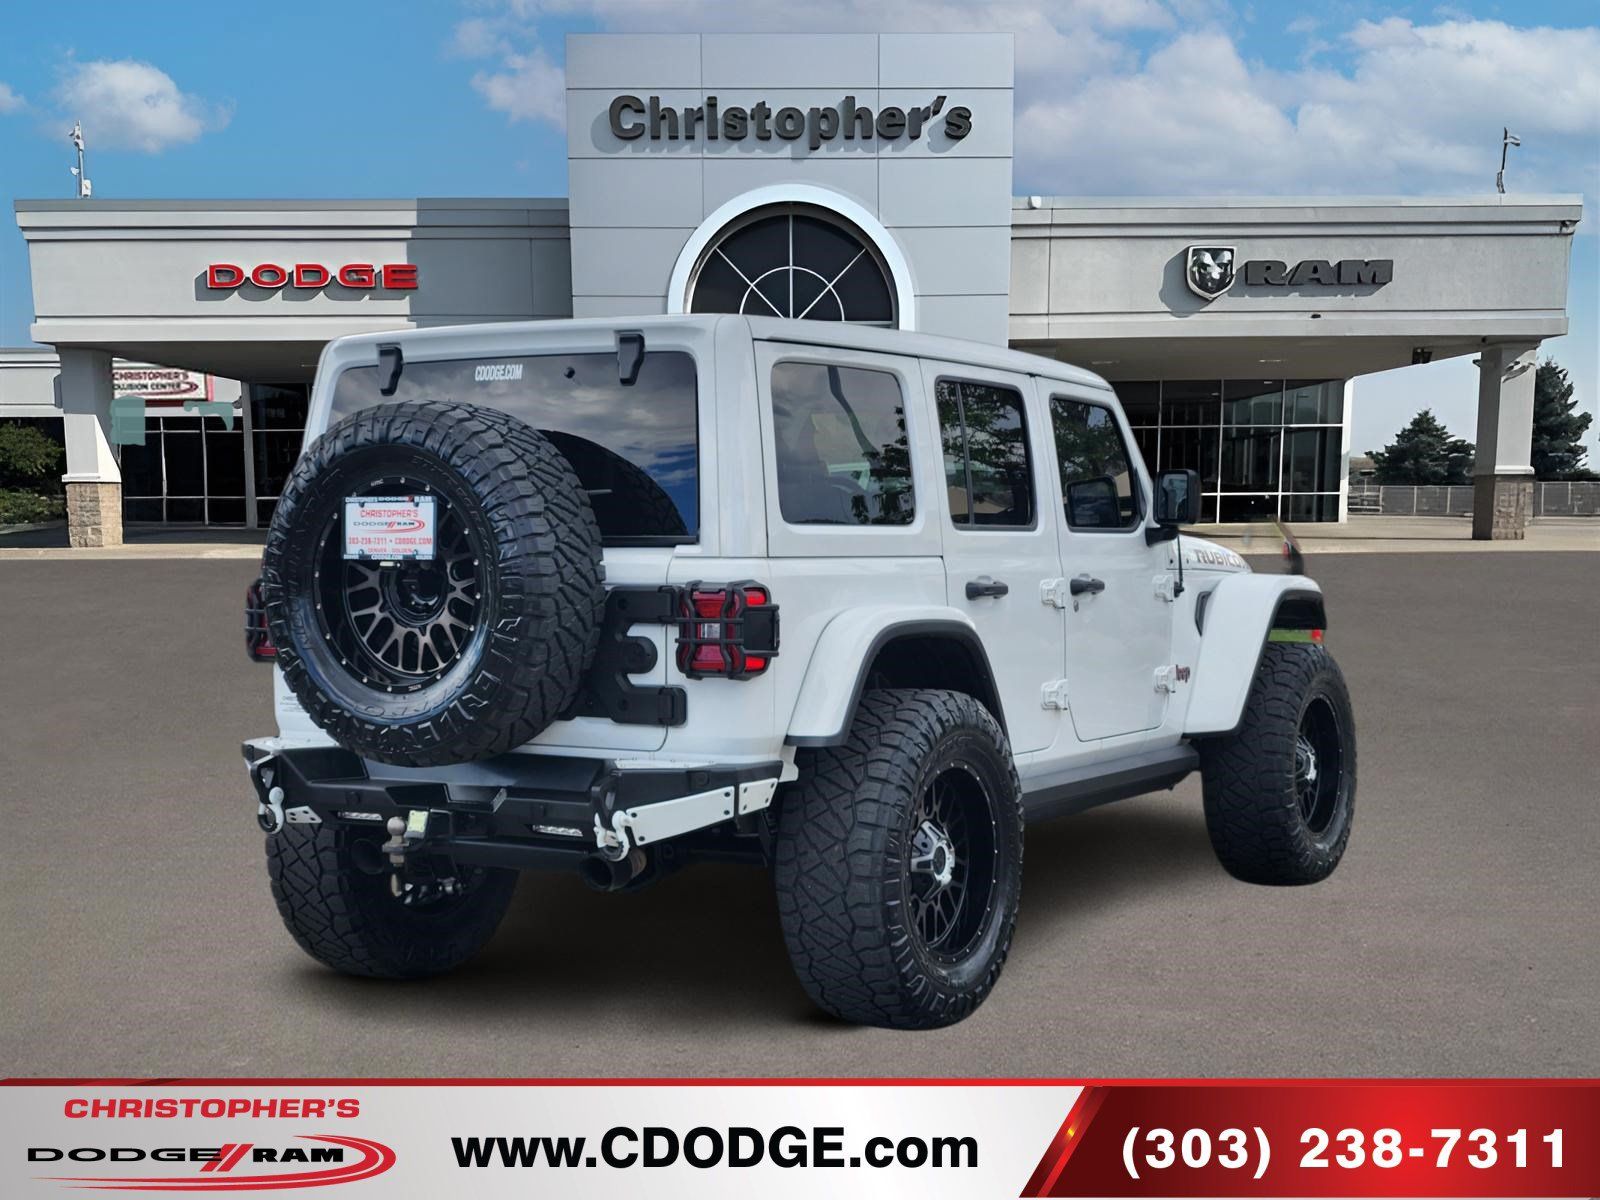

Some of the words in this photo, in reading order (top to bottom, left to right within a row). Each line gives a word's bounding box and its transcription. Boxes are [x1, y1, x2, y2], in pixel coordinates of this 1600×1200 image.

[609, 95, 972, 150] Christopher's
[207, 263, 418, 289] DODGE
[1245, 260, 1393, 285] RAM
[475, 364, 523, 381] CDODGE.COM
[112, 382, 148, 391] OLLISION
[150, 382, 181, 390] CENTER
[360, 509, 418, 518] CHRISTOPHER'S
